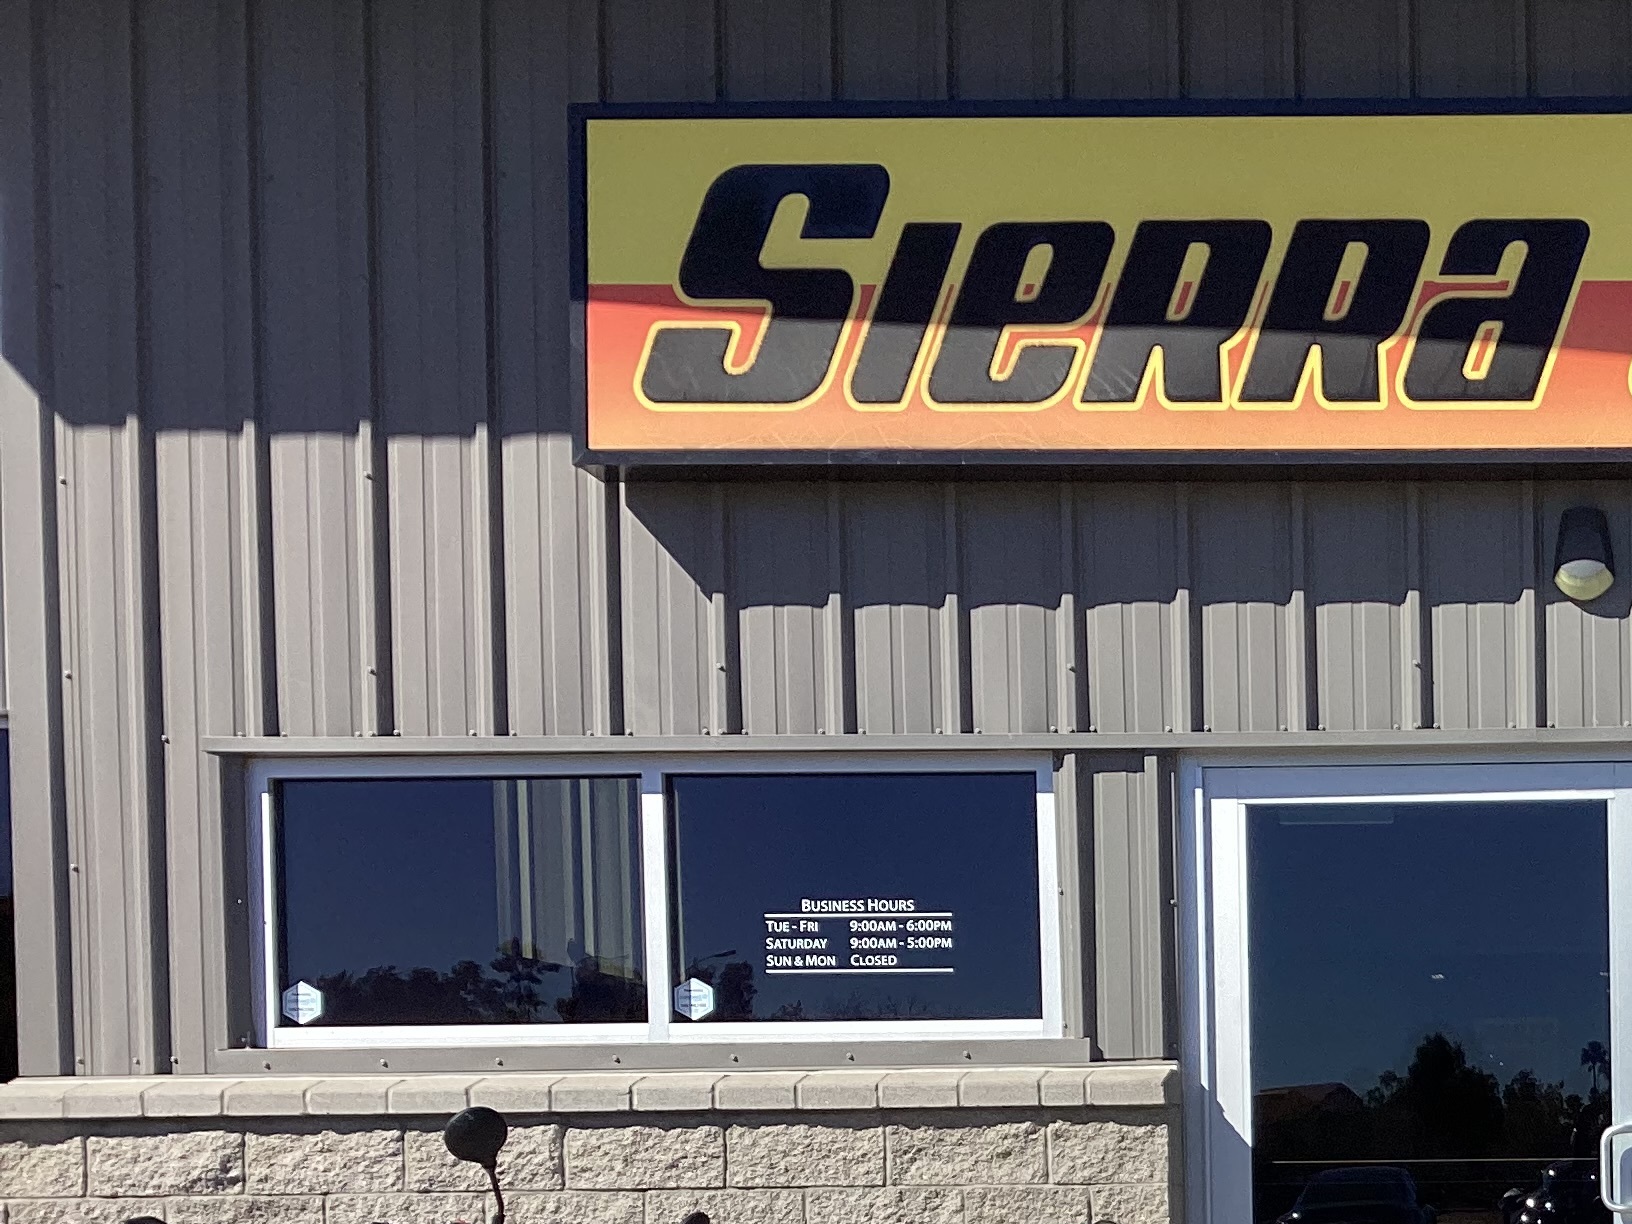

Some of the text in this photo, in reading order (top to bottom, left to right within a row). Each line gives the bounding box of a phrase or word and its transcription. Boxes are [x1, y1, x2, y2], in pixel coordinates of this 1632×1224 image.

[636, 162, 1591, 407] Sierra
[801, 899, 915, 912] BUSINESS HOURS
[765, 920, 790, 932] TUE
[799, 920, 819, 932] FRI
[849, 920, 897, 932] 9:00AM
[906, 919, 952, 931] 6:00PM
[765, 938, 828, 950] SATURDAY
[849, 937, 897, 949] 9:00AM
[906, 937, 953, 949] 5:00PM
[766, 954, 898, 967] SUN & MON CLOSED
